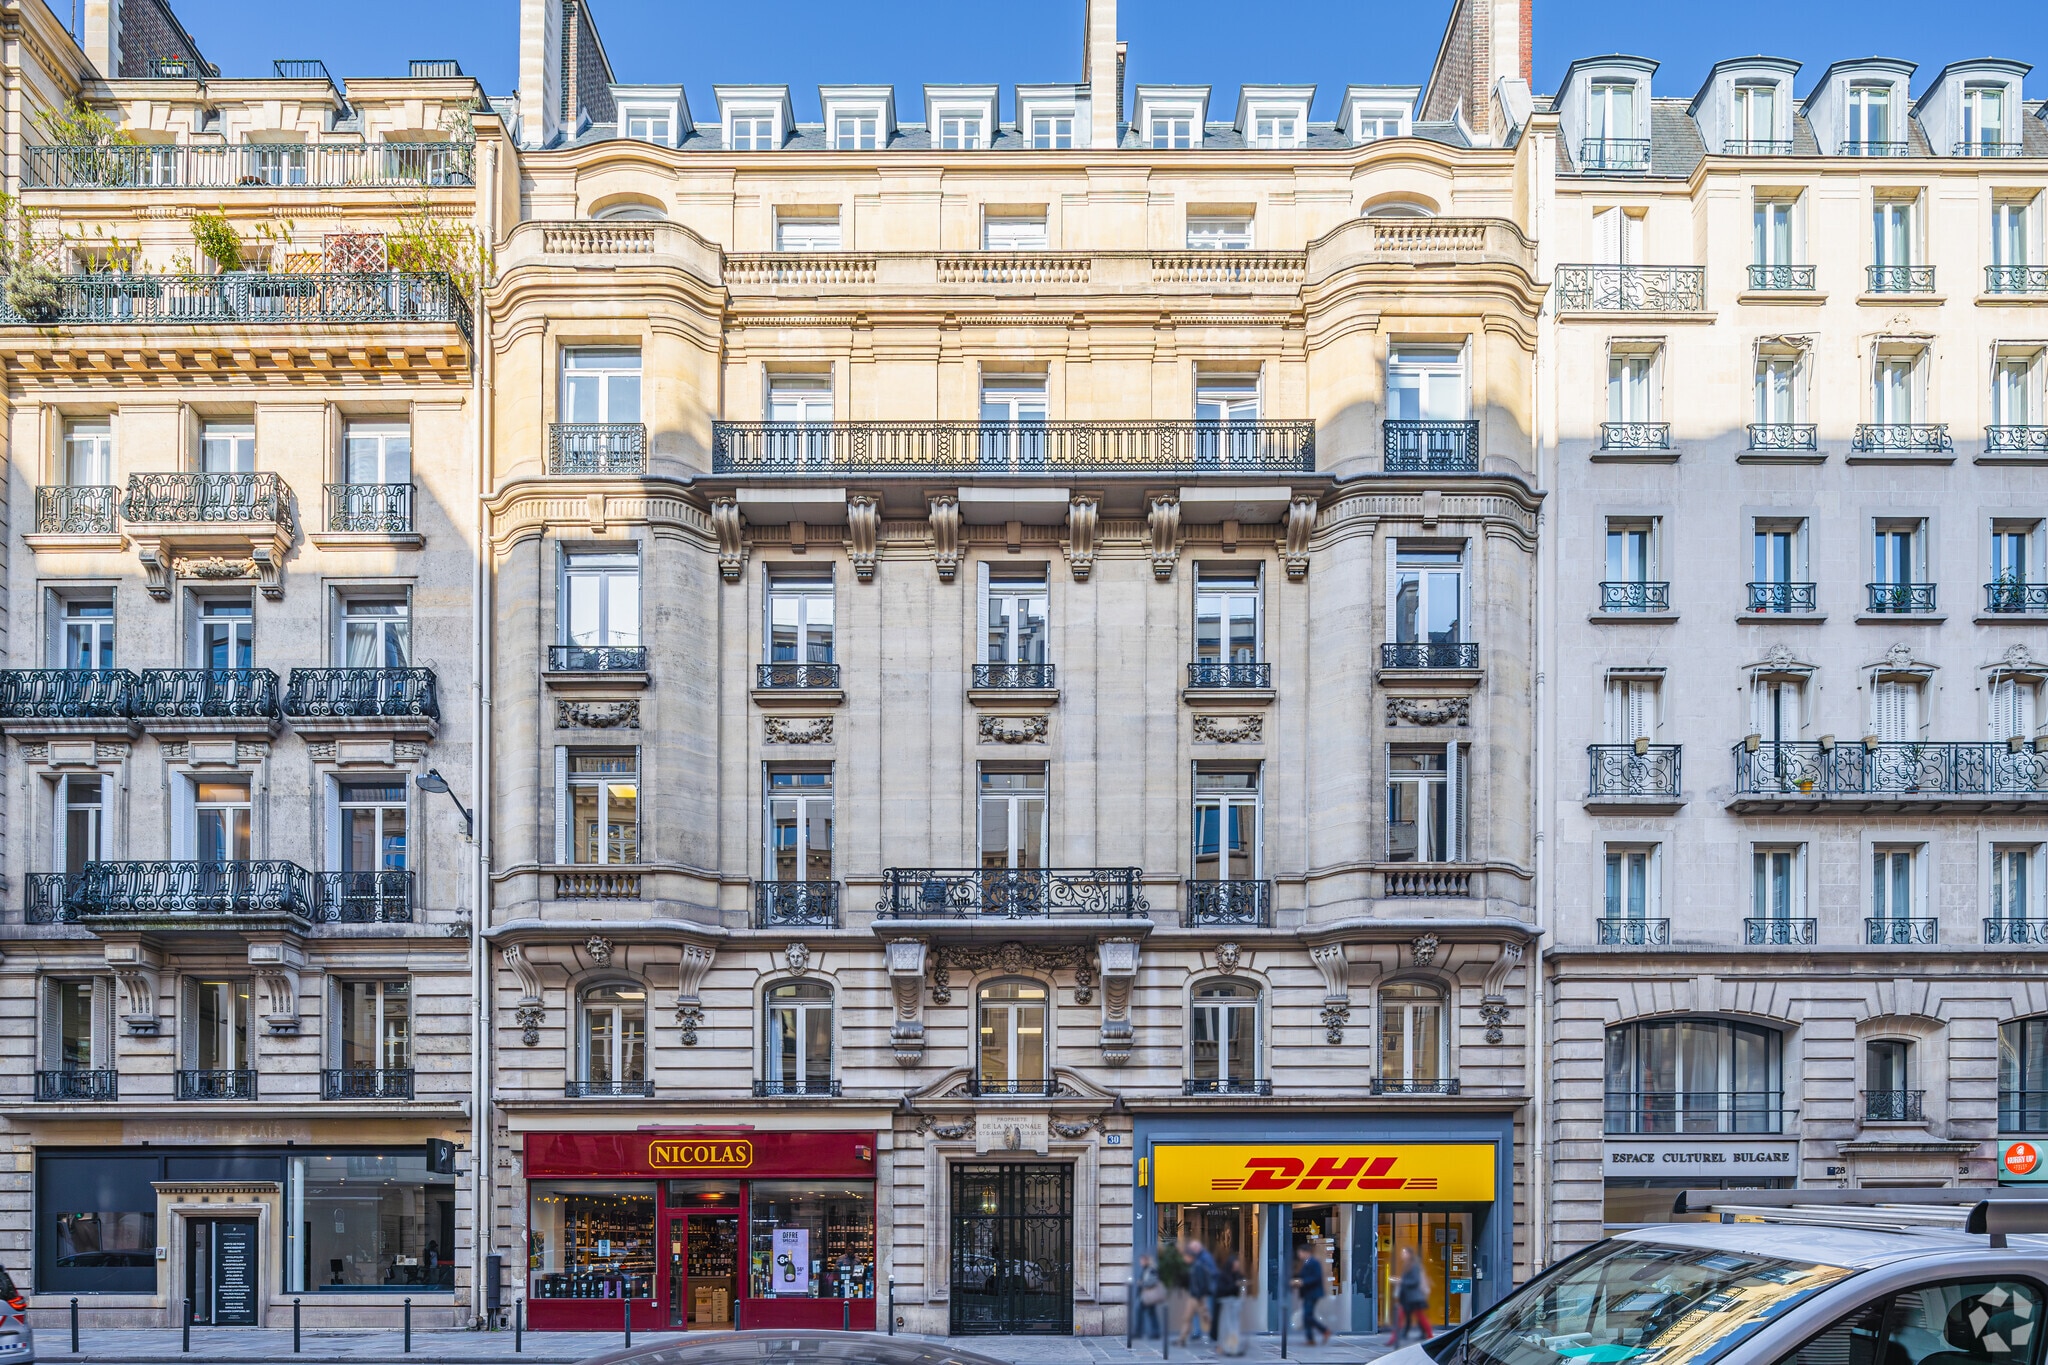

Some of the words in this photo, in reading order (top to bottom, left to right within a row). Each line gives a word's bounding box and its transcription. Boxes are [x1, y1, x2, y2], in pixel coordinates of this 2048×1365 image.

[1108, 1135, 1120, 1144] 30
[655, 1146, 747, 1163] NICOLAS
[1612, 1153, 1655, 1163] ESPACE
[1662, 1153, 1726, 1163] CULTUREL
[1733, 1152, 1790, 1163] BULGARE
[1241, 1157, 1408, 1191] DHL
[1835, 1167, 1846, 1175] 28
[1958, 1166, 1969, 1175] 28
